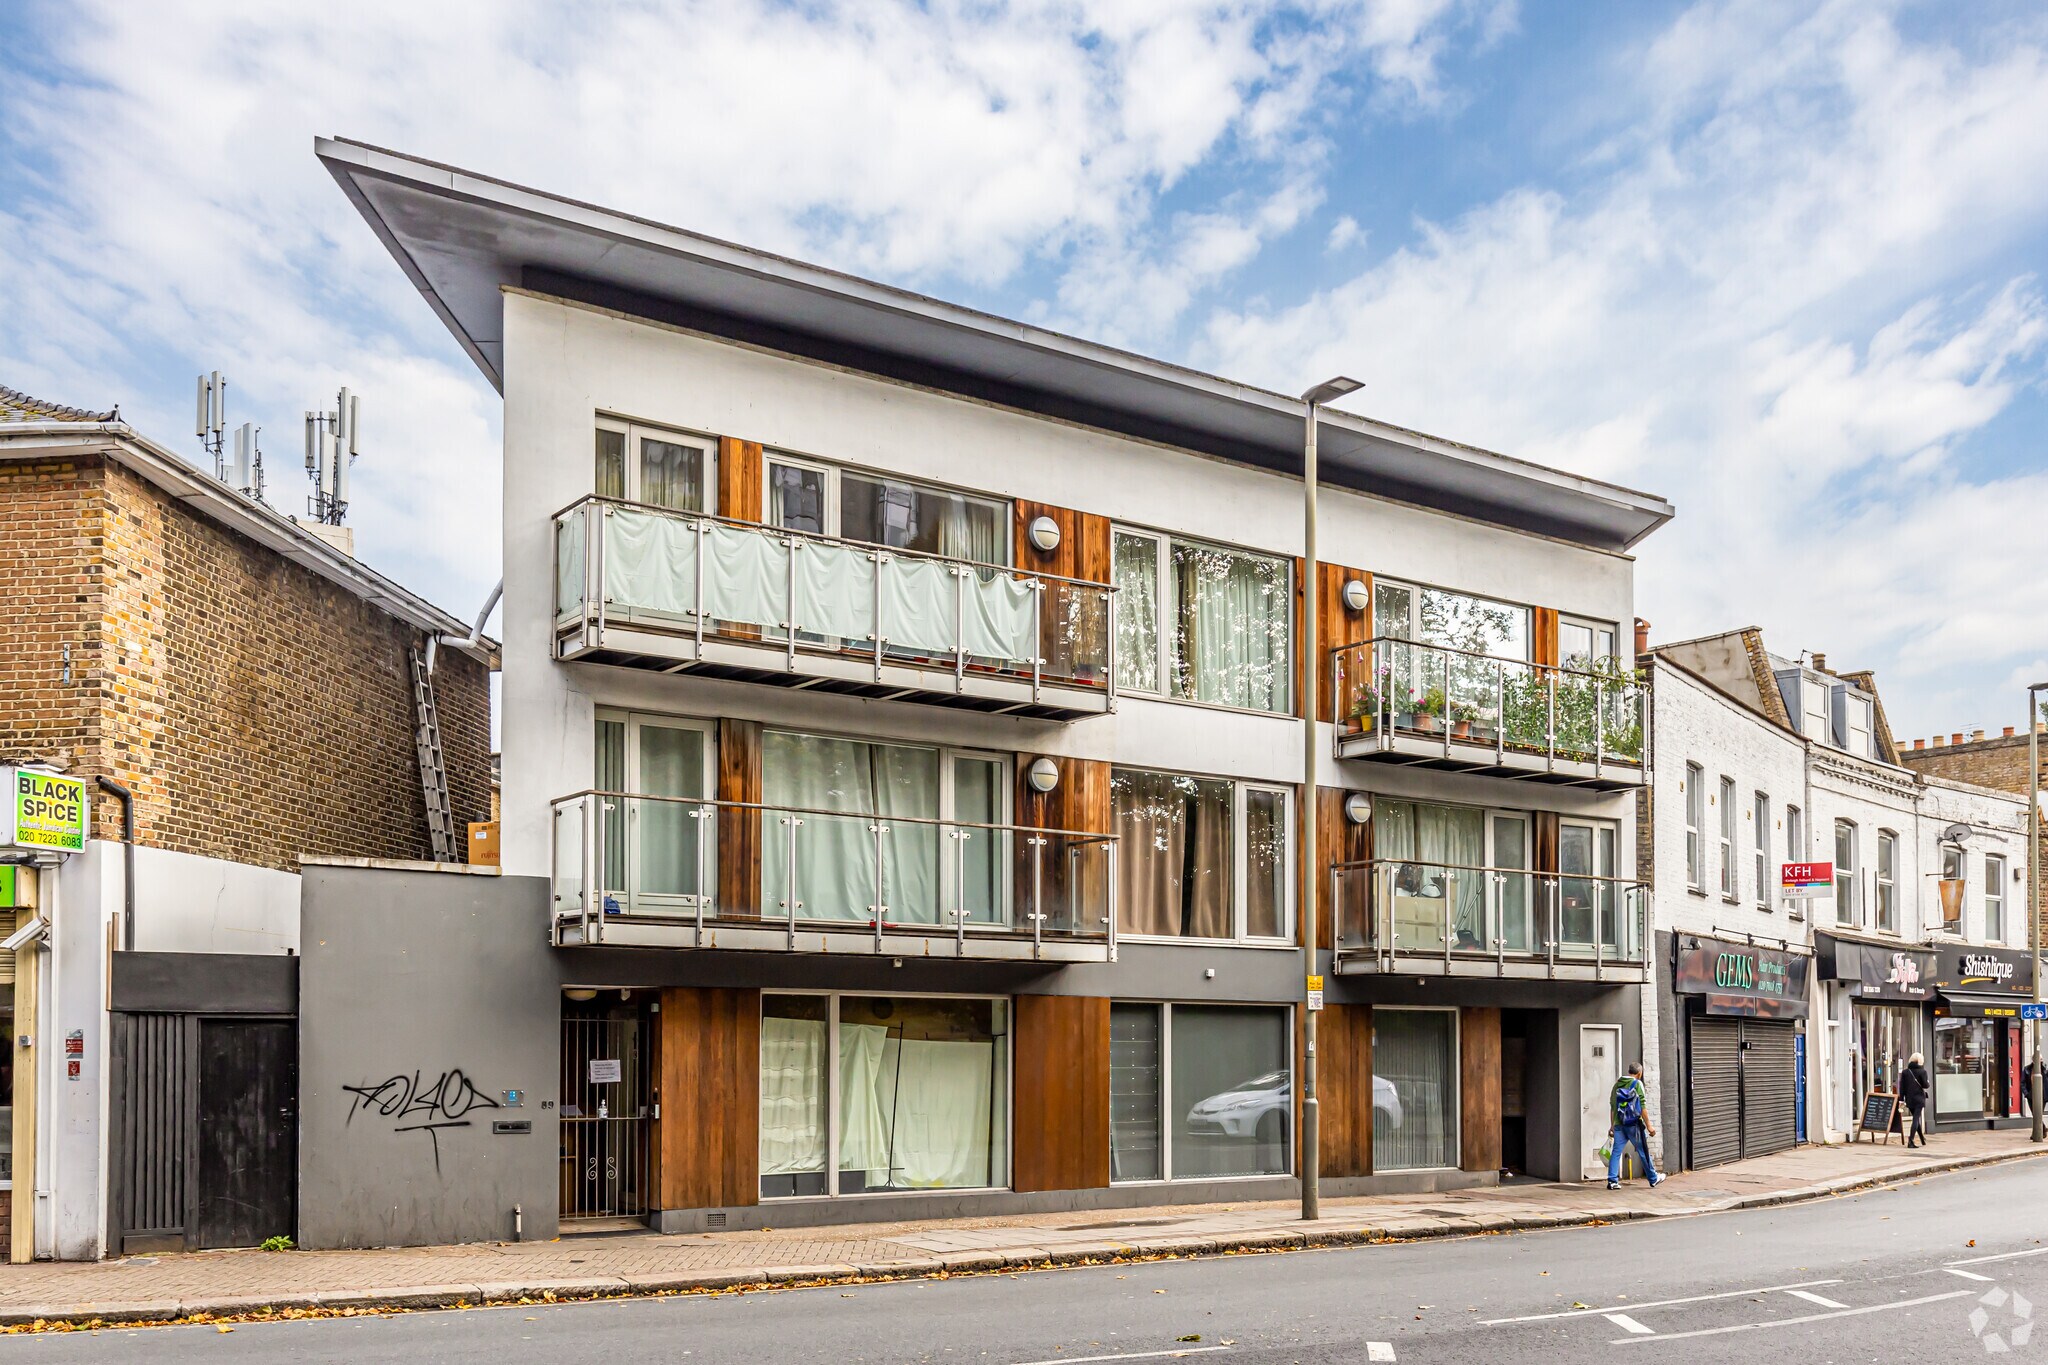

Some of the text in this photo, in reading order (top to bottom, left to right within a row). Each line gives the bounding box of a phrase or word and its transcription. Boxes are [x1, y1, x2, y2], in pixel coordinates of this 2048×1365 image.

[19, 777, 80, 803] BLACK
[19, 830, 81, 848] 020 7223 6083
[1785, 866, 1811, 877] KFH
[1964, 953, 2013, 985] Shishlique
[541, 1100, 554, 1110] 89
